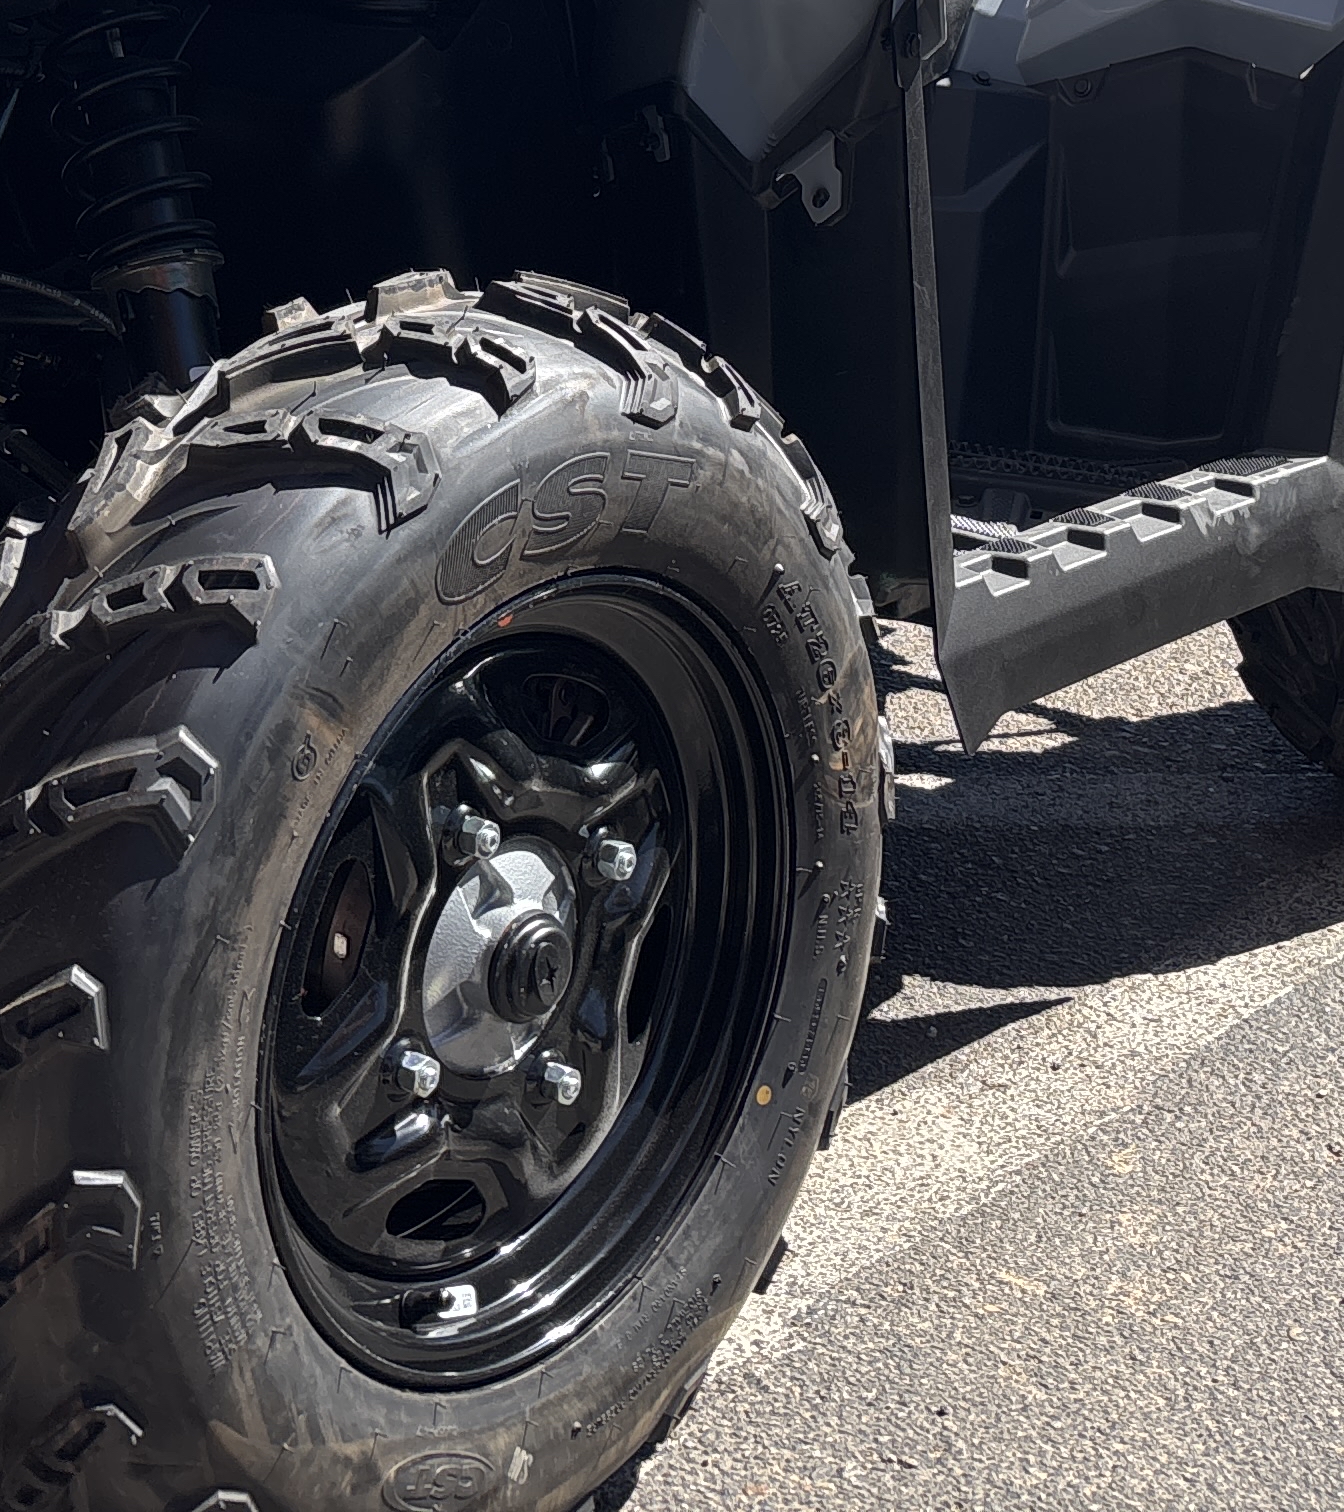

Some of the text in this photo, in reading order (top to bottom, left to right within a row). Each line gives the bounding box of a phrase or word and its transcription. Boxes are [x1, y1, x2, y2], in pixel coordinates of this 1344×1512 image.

[434, 449, 698, 606] CST
[764, 1105, 807, 1188] NYLON
[401, 1455, 486, 1504] CST
